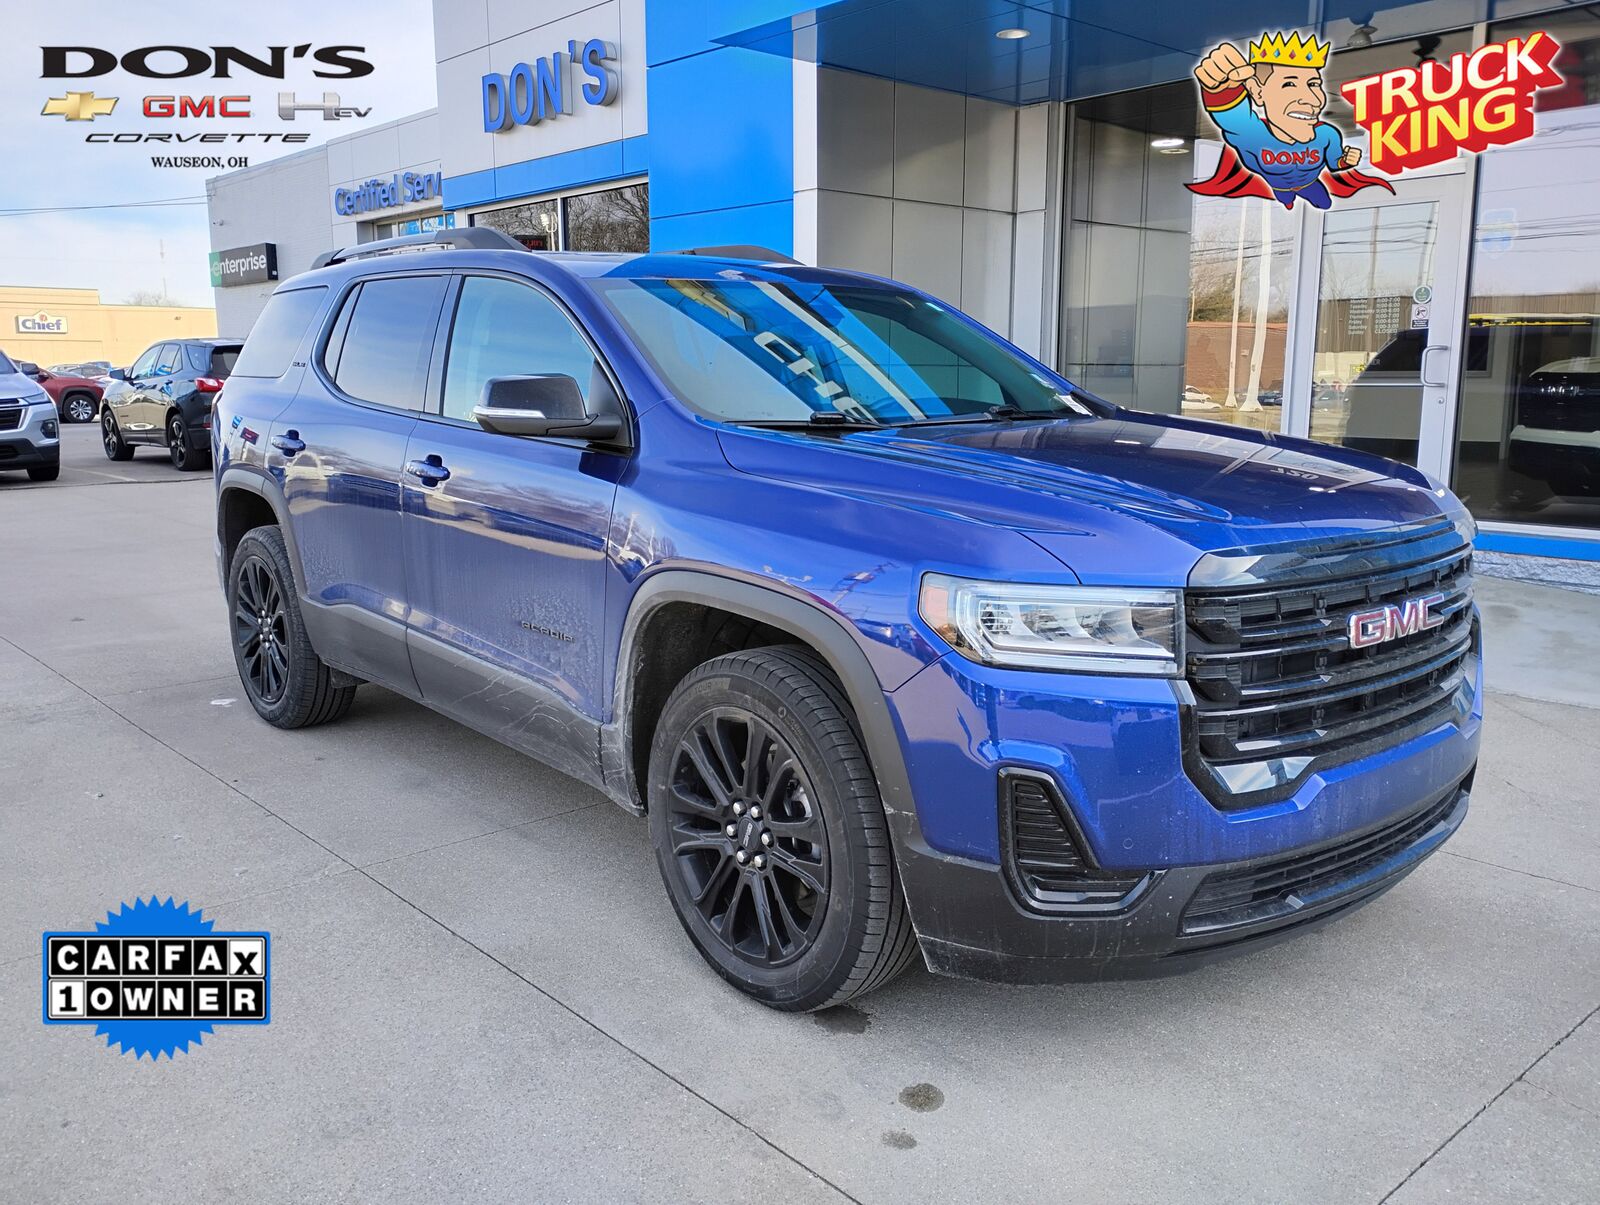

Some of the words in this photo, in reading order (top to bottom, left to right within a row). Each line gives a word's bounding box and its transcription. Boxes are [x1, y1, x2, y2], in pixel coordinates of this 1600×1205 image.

[481, 38, 616, 134] DON'S
[335, 173, 401, 216] Certified
[211, 251, 267, 277] enterprise
[21, 318, 62, 331] Chief
[1349, 593, 1445, 649] GMC
